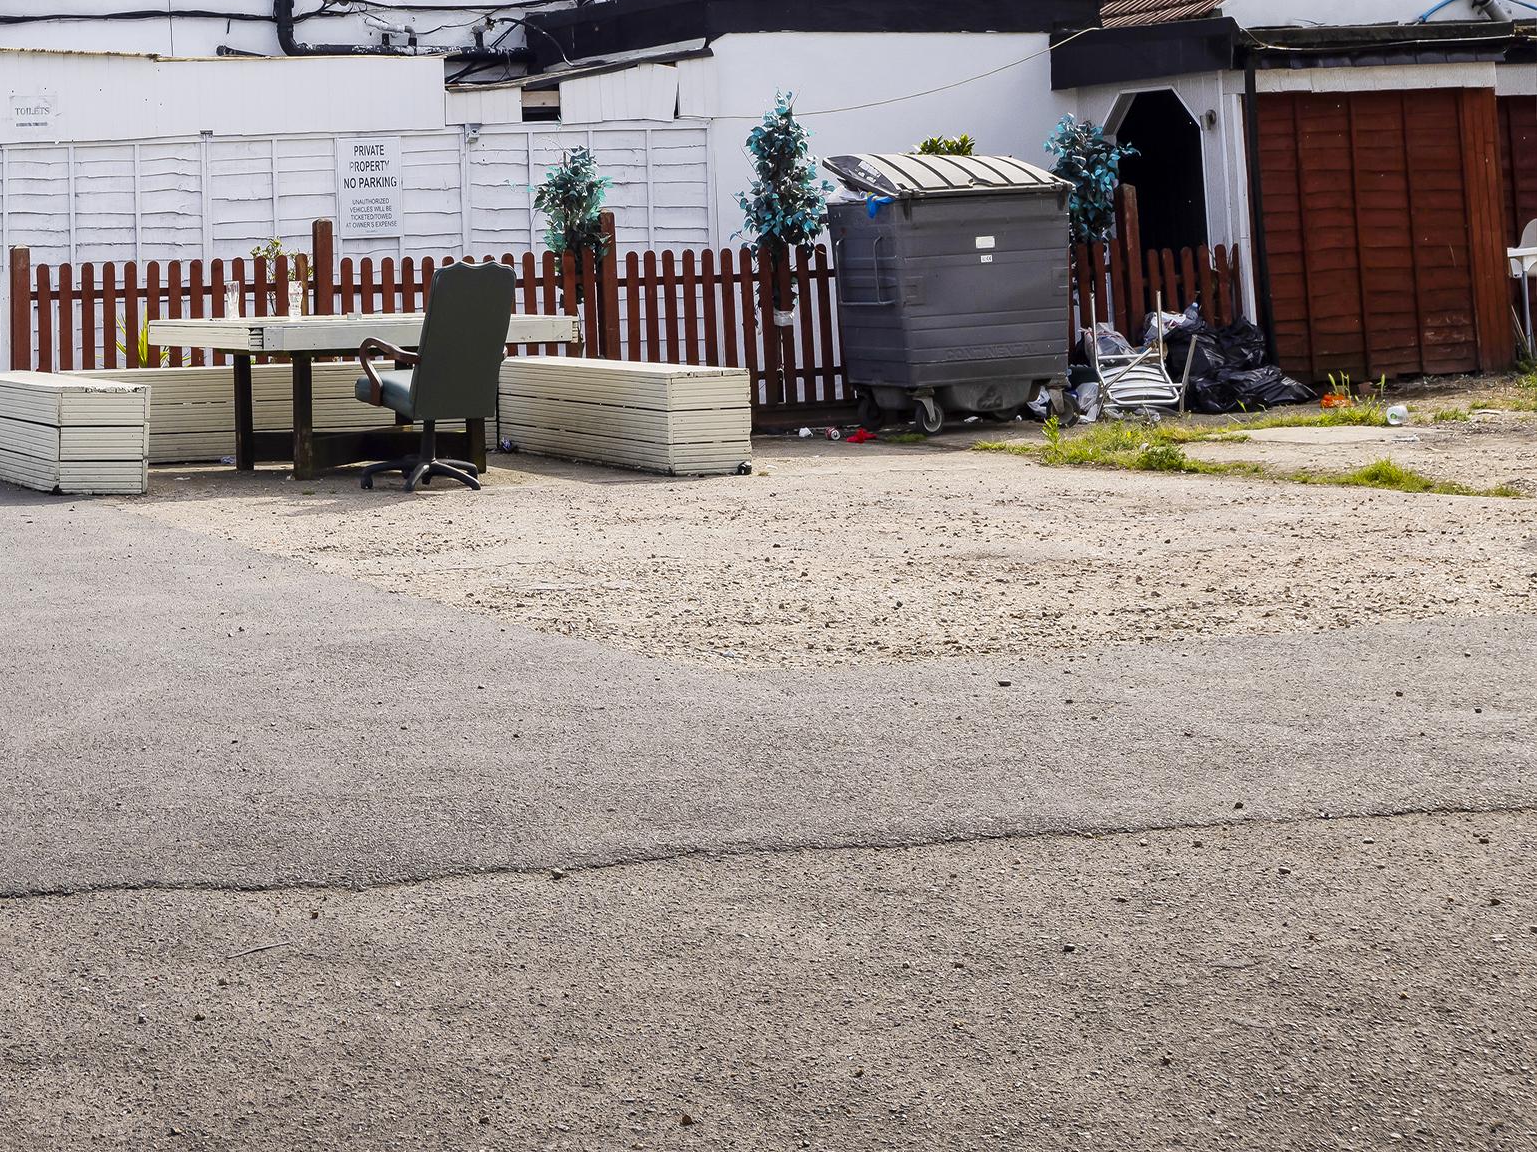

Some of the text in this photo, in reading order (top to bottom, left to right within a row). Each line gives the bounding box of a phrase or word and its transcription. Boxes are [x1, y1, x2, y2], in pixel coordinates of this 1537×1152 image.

[354, 145, 385, 156] PRIVATE
[349, 160, 390, 172] PROPERTY
[344, 177, 397, 189] NO PARKING
